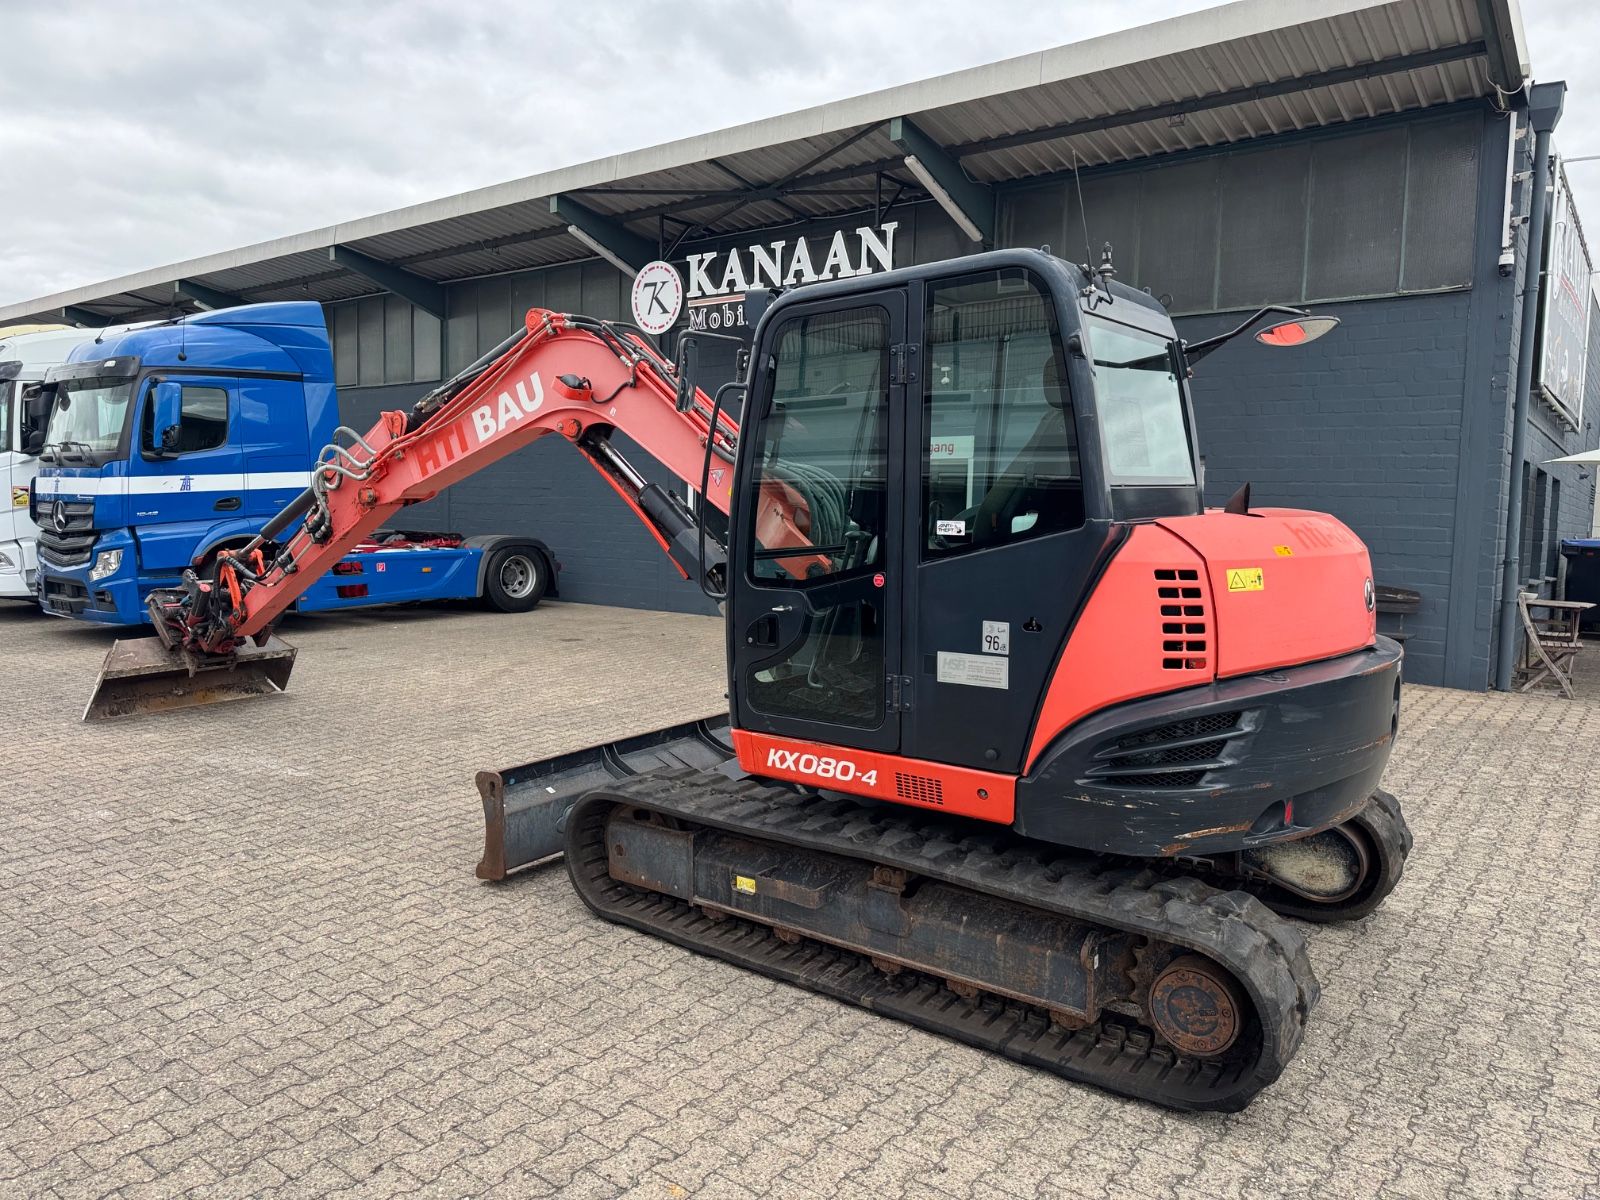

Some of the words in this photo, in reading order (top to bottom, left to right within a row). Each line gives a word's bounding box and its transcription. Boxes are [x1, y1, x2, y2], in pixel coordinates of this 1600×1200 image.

[686, 222, 898, 298] KANAAN
[414, 421, 470, 477] HTI
[472, 371, 544, 443] BAU
[985, 634, 1000, 651] 96
[767, 748, 878, 786] KX080-4
